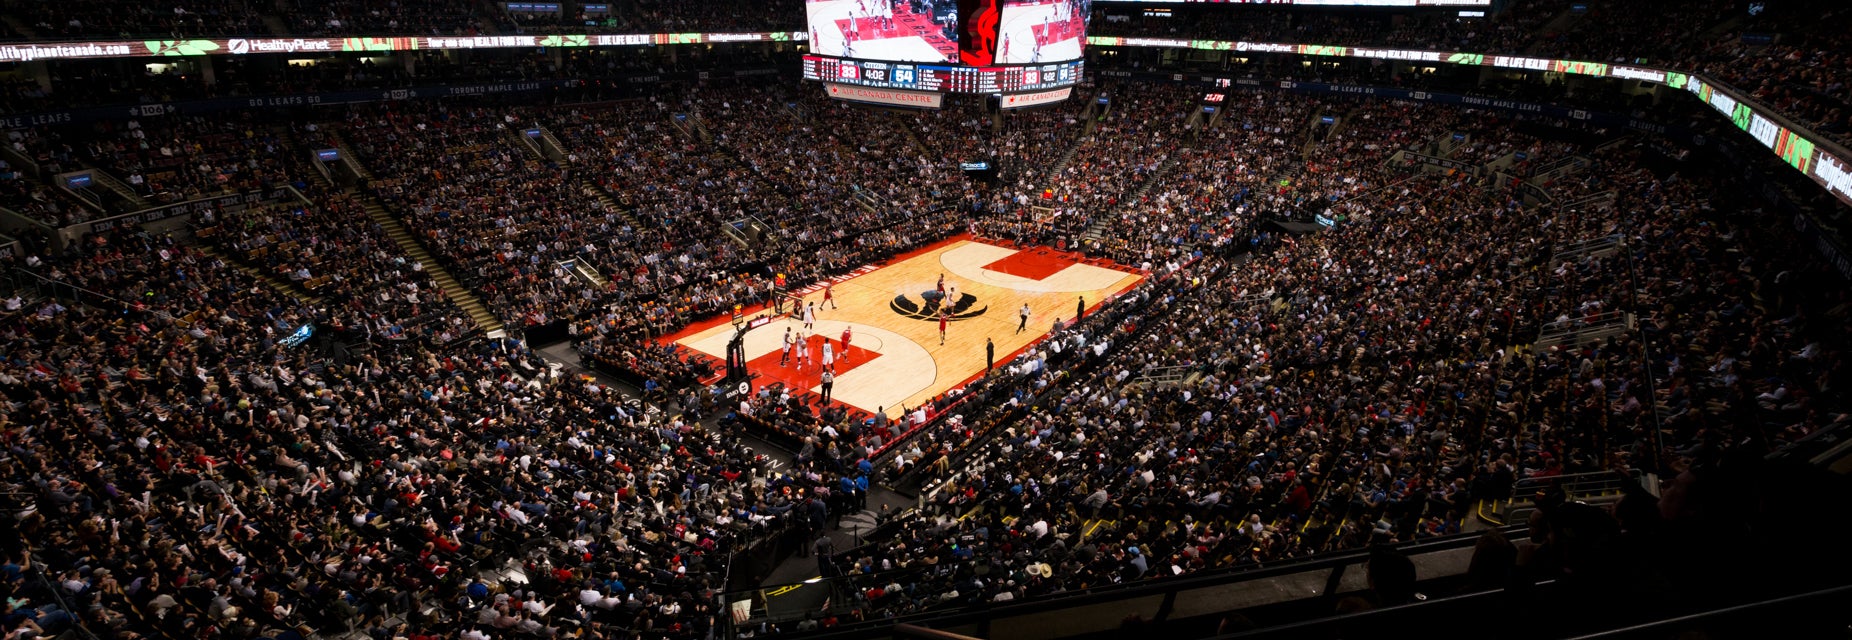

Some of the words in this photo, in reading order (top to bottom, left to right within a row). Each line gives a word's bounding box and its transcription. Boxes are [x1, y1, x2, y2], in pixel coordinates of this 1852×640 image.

[251, 38, 330, 52] HealthyPlanet
[1248, 43, 1292, 53] HealthyPlanet
[865, 69, 885, 80] 4:02
[895, 70, 913, 82] 54
[392, 90, 407, 98] 107
[450, 86, 485, 95] TORONTO
[488, 84, 512, 92] MAPLE
[517, 82, 540, 90] LEAFS
[250, 98, 263, 107] GO
[269, 97, 302, 106] LEAFS
[308, 95, 321, 103] GO
[858, 90, 892, 99] CANADA
[895, 93, 932, 103] CENTRE
[1019, 94, 1030, 102] AIR
[1032, 92, 1053, 101] CANADA
[1462, 96, 1490, 105] TORONTO
[1493, 99, 1515, 108] MAPLE
[1519, 104, 1541, 112] LEAFS
[143, 105, 162, 115] 106
[32, 112, 72, 125] LEAFS
[271, 189, 286, 198] BM
[146, 209, 165, 221] IBM
[170, 204, 189, 215] IBM
[96, 221, 114, 232] IBM
[726, 389, 739, 399] BMO
